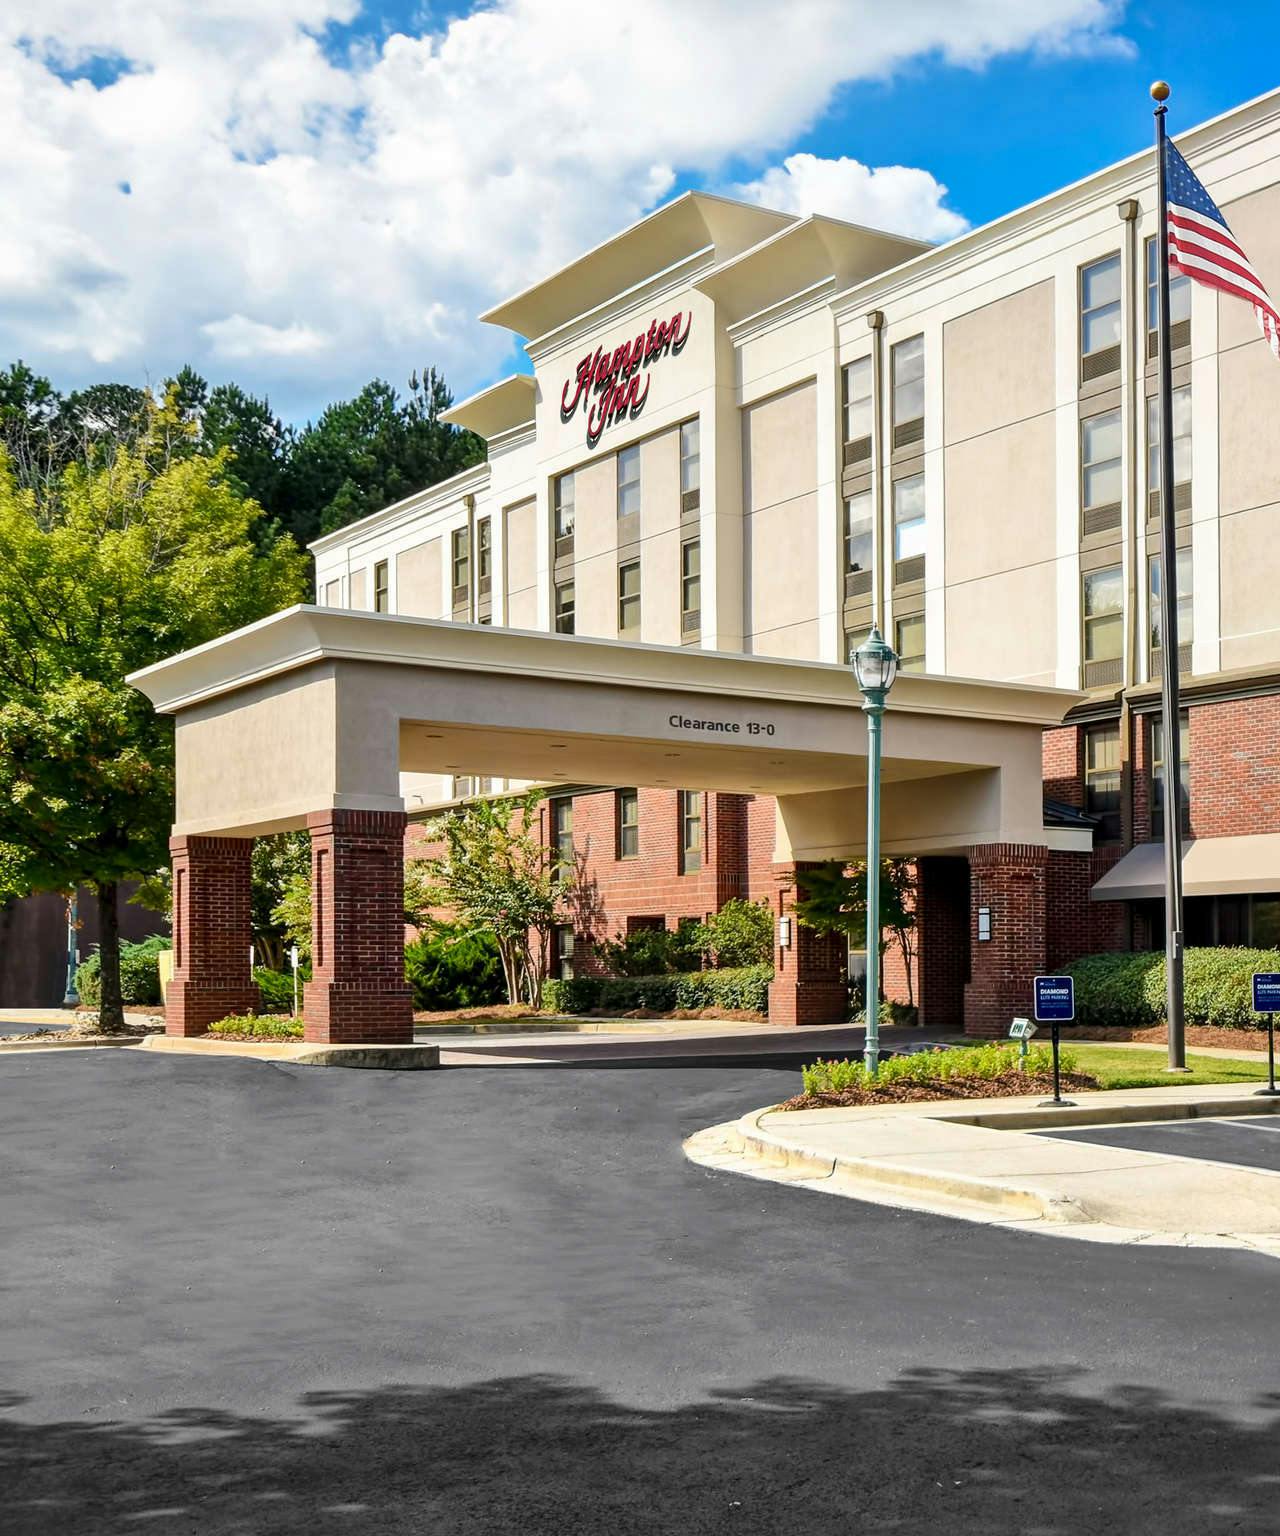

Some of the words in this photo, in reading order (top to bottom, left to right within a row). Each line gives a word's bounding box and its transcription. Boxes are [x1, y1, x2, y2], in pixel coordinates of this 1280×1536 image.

[561, 311, 692, 416] Hampton
[587, 373, 650, 440] Inn
[668, 715, 740, 733] Clearance
[746, 722, 775, 736] 13-0
